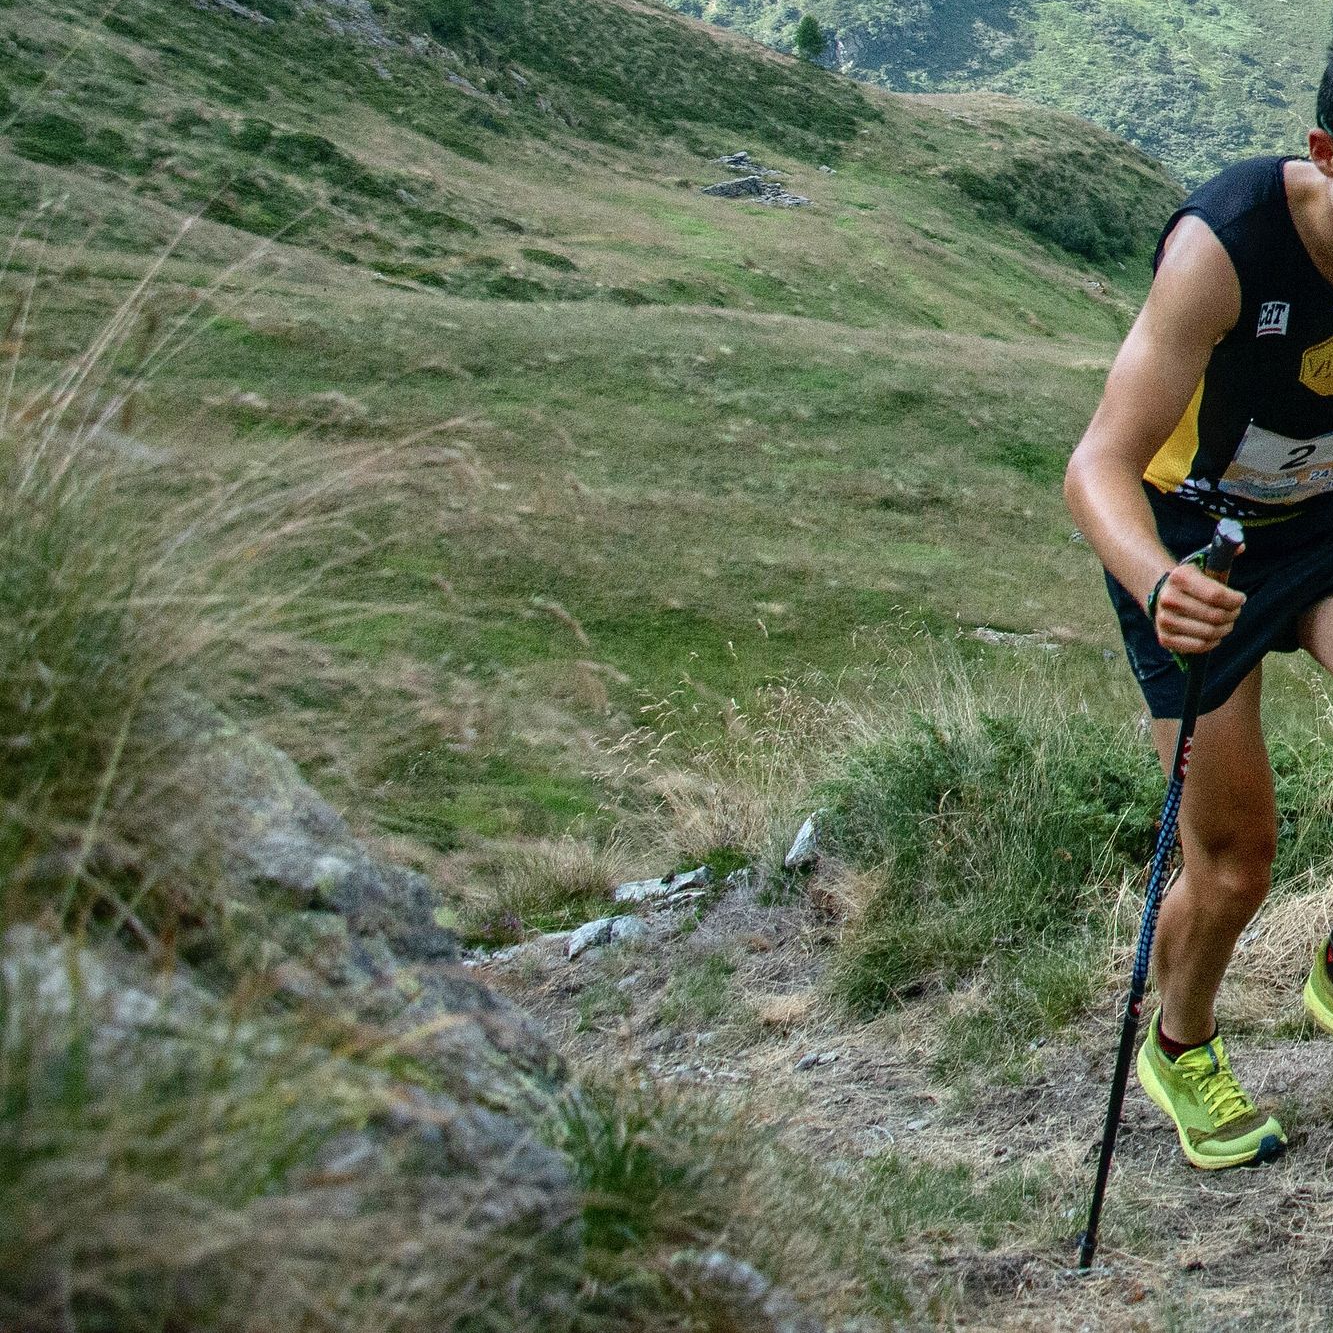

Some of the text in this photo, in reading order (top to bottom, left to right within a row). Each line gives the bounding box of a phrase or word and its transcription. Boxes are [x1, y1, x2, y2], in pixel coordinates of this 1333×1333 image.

[1259, 303, 1286, 327] CdT
[1279, 444, 1317, 470] 2
[1310, 469, 1330, 481] 24
